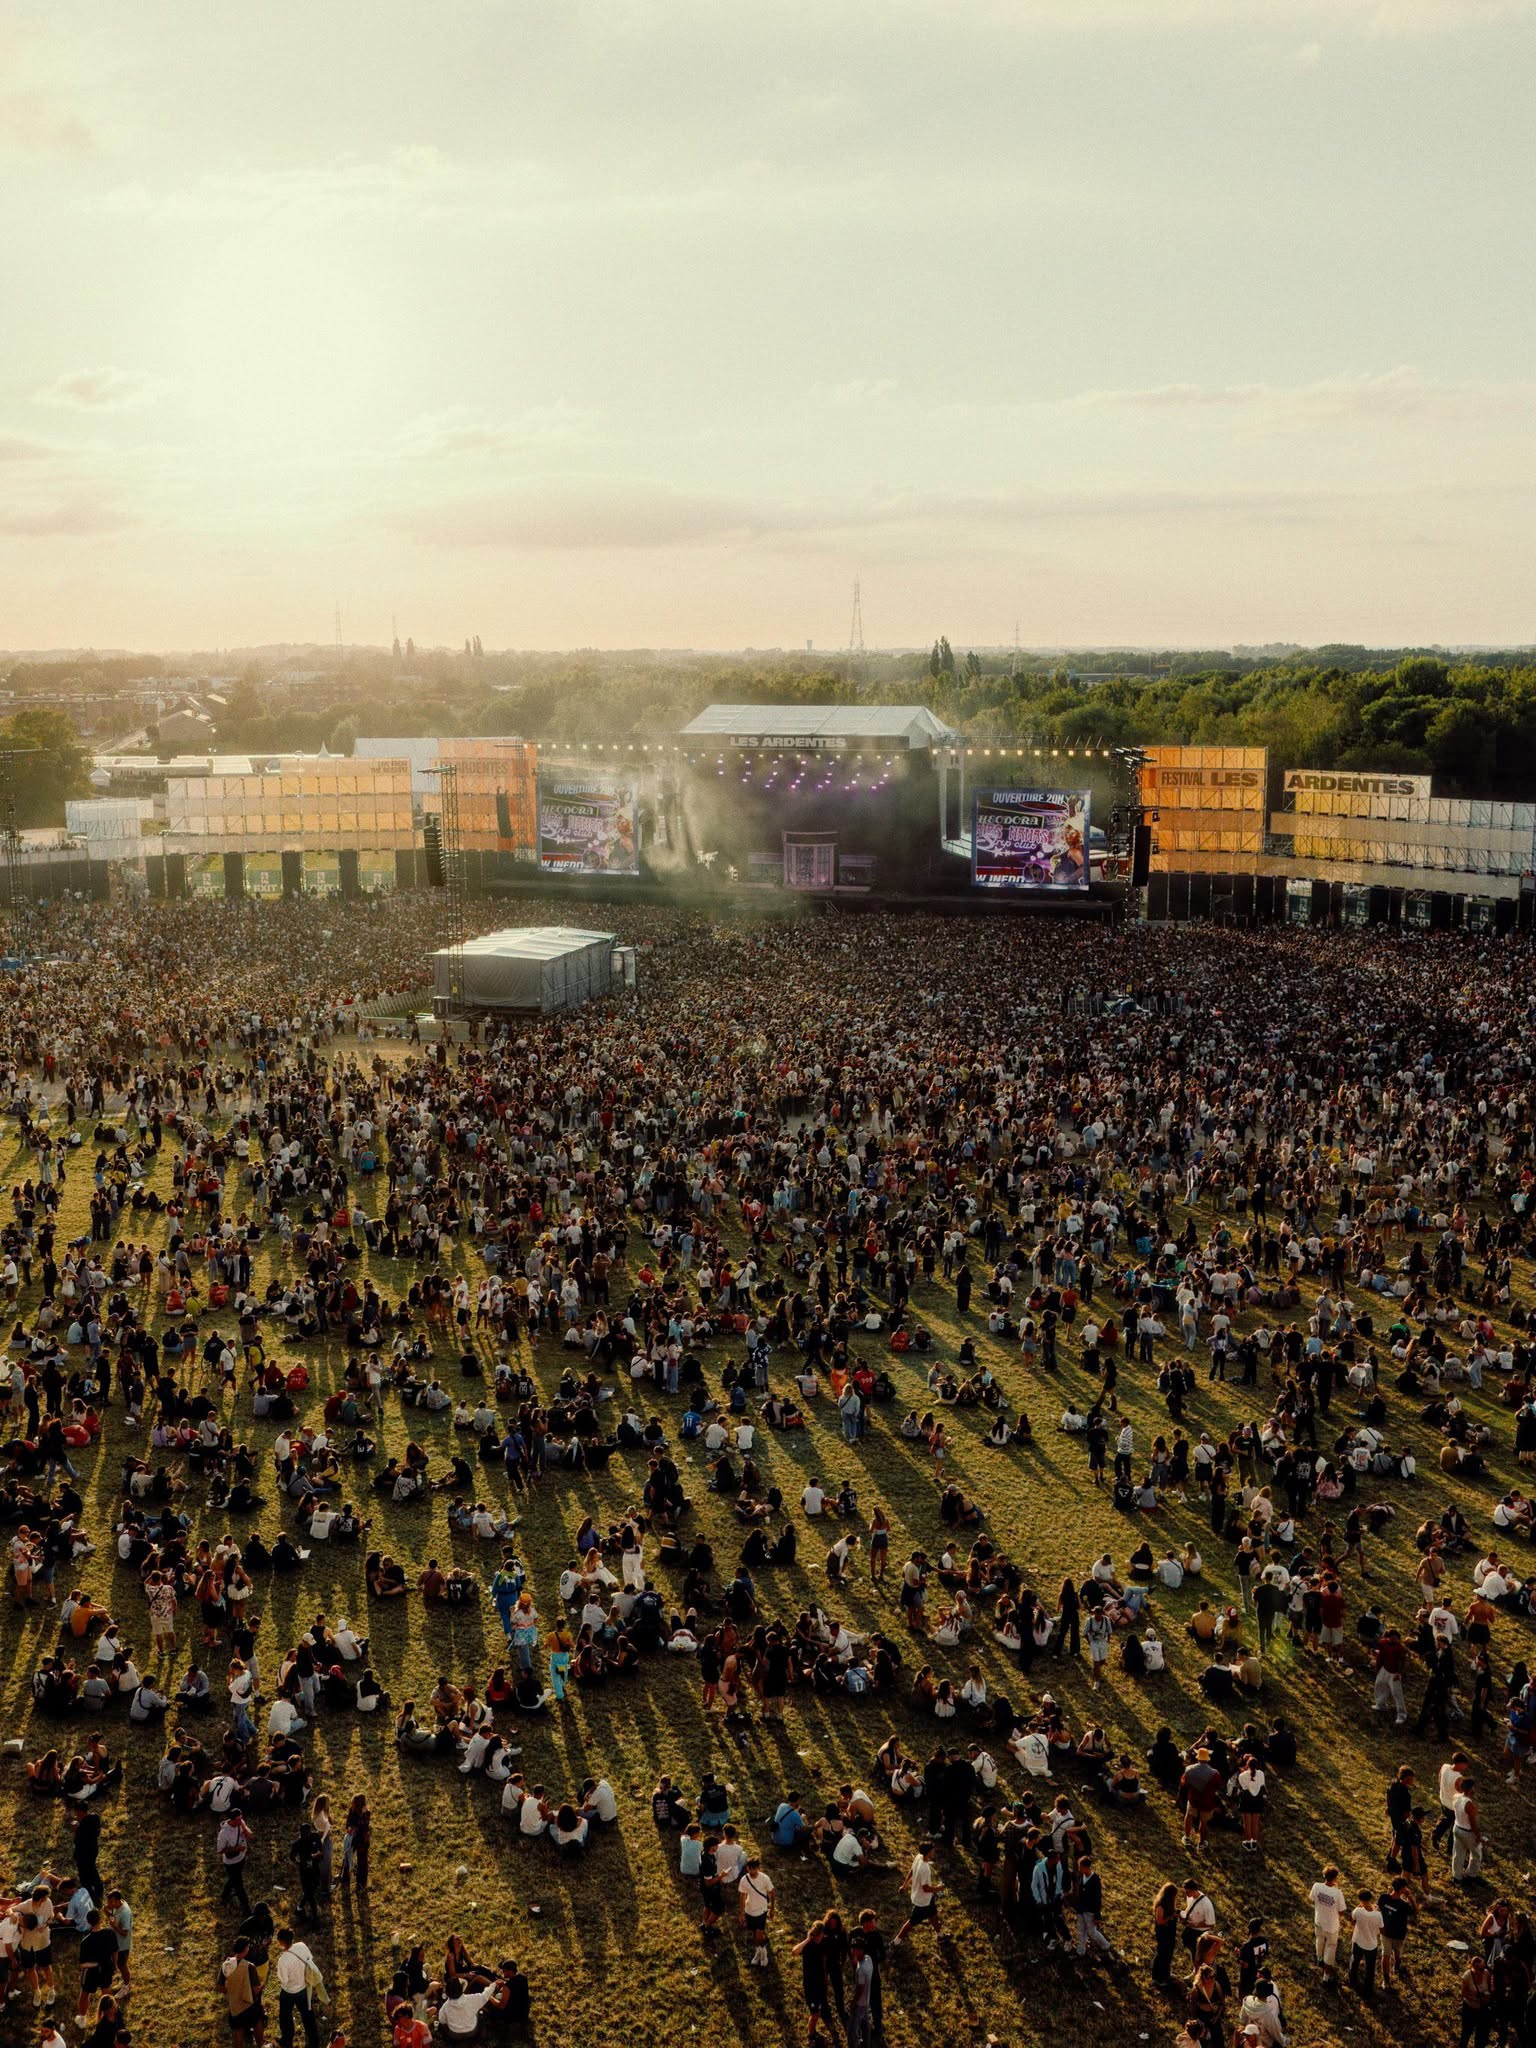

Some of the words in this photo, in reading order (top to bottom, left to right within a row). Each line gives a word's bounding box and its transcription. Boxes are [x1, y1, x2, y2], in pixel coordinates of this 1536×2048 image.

[729, 736, 758, 748] LES
[761, 736, 847, 748] ARDENTES
[1161, 771, 1206, 786] FESTIVAL
[1211, 771, 1258, 788] LES
[1287, 774, 1415, 796] ARDENTES
[993, 792, 1044, 803] OUVERTURE
[253, 884, 277, 892] EXIT
